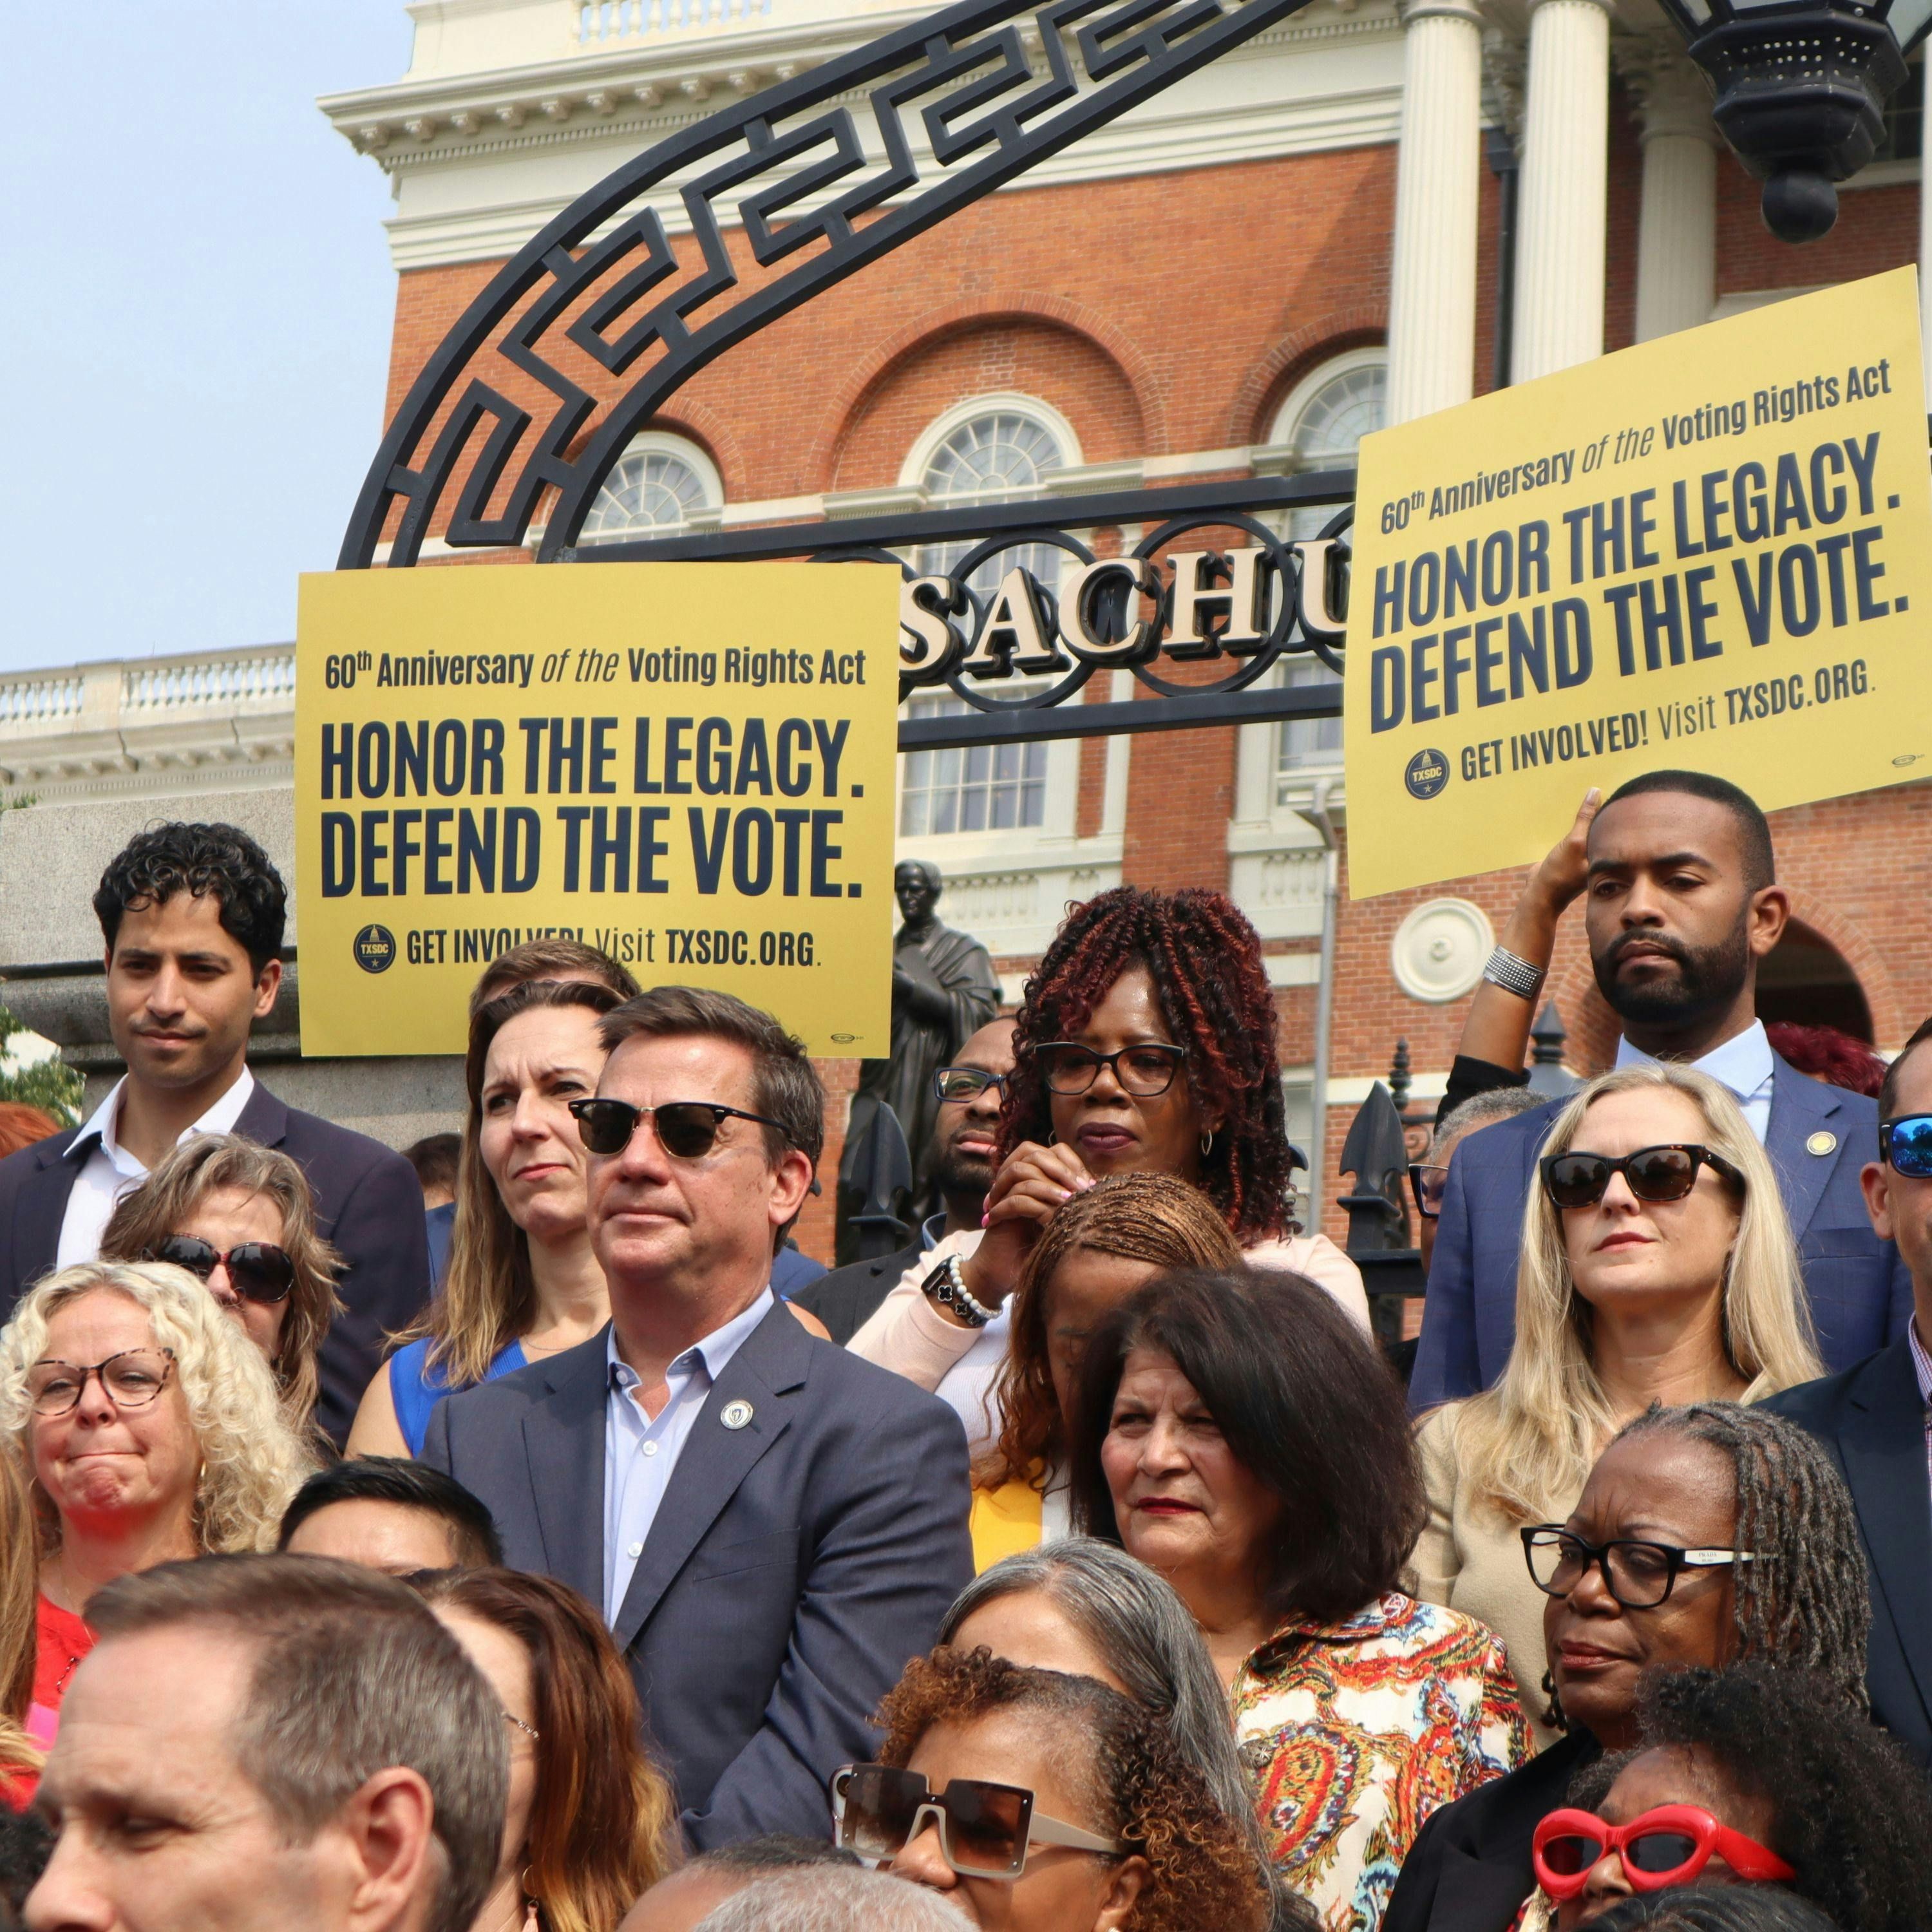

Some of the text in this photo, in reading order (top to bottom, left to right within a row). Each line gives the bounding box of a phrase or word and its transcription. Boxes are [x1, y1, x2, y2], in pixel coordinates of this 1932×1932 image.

[1380, 359, 1891, 535] 60th Anniversary of the Voting Rights Act
[1372, 431, 1900, 639] HONOR THE LEGACY.
[325, 646, 866, 689] 60th Anniversary of the Voting Rights Act
[1370, 525, 1909, 734] DEFEND THE VOTE.
[321, 717, 864, 800] HONOR THE LEGACY.
[1461, 659, 1877, 782] GET INVOLVED! Visit TXSDC.ORG.
[1412, 766, 1442, 782] TXSDC
[321, 806, 862, 898] DEFEND THE VOTE.
[361, 943, 389, 954] TXSDC
[407, 929, 448, 965] GET
[595, 927, 655, 962] Visit
